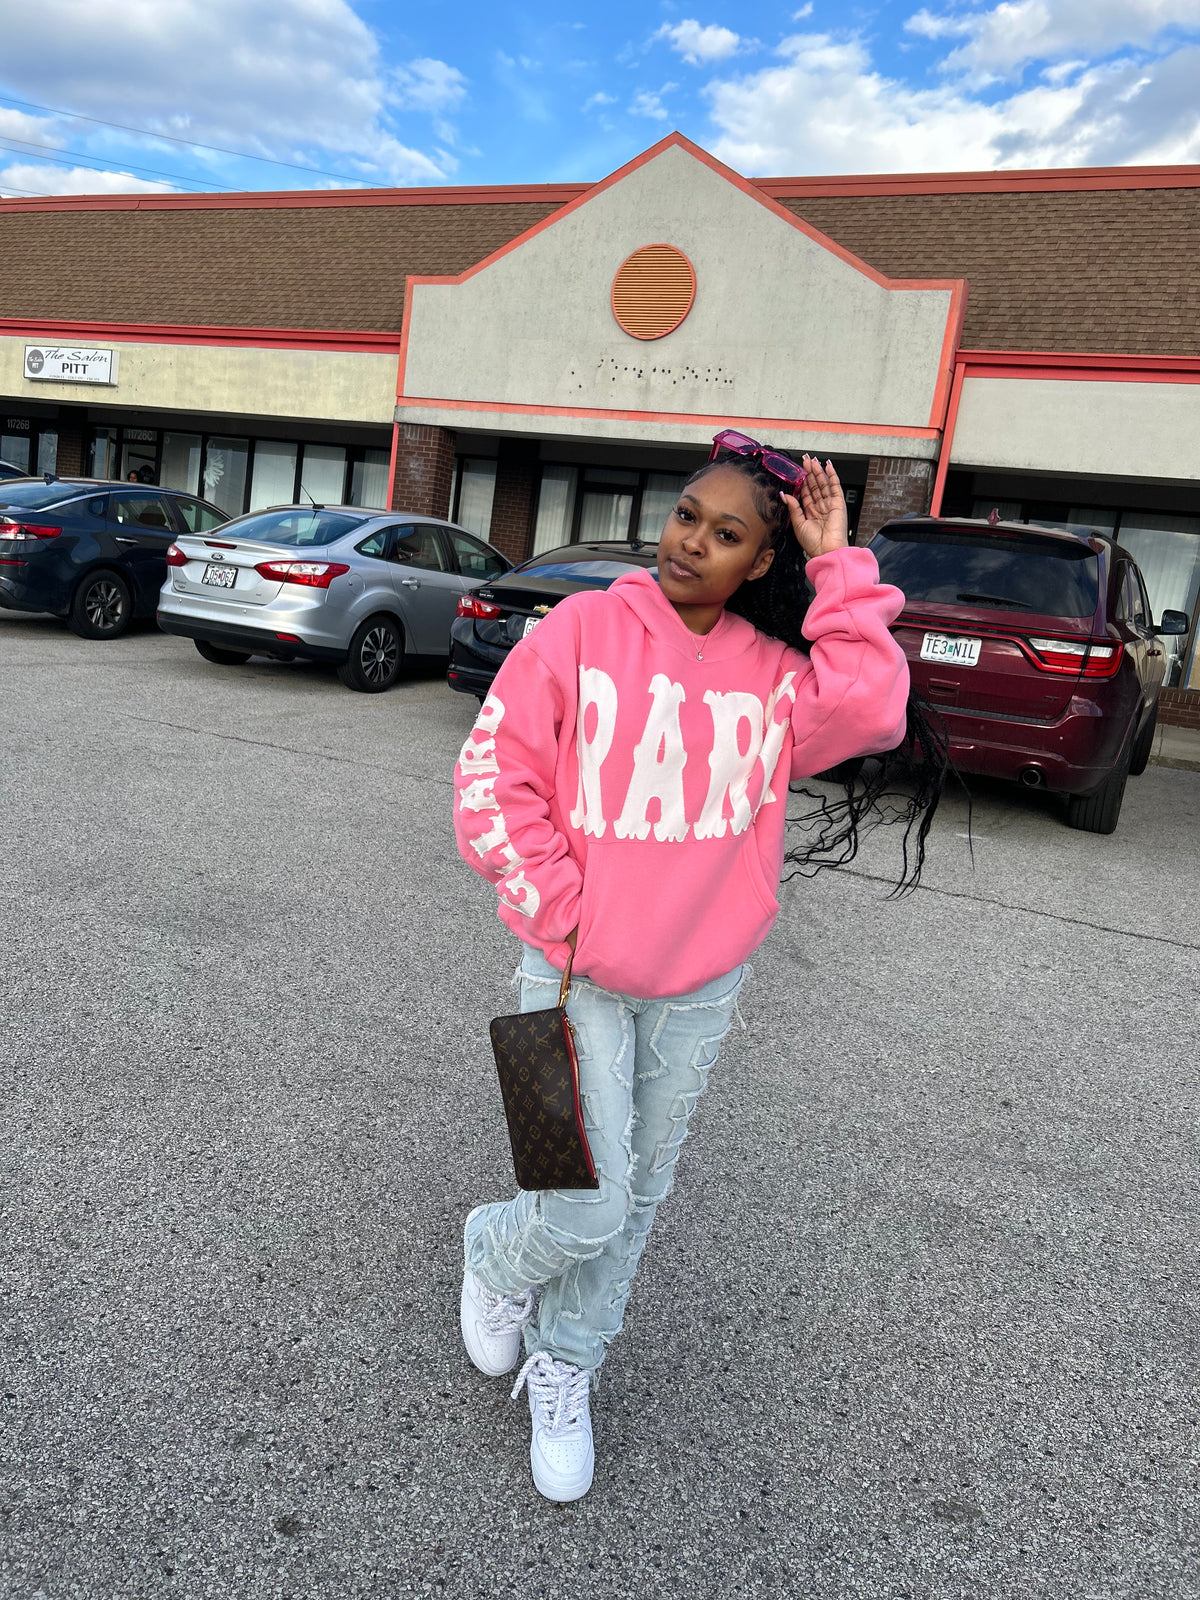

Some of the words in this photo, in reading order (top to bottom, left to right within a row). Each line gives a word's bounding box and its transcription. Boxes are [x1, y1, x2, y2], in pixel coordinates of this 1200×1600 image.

[45, 347, 65, 360] The
[67, 351, 108, 362] Salon
[61, 362, 89, 374] PITT
[7, 418, 30, 430] 11726B
[926, 637, 948, 655] TE3
